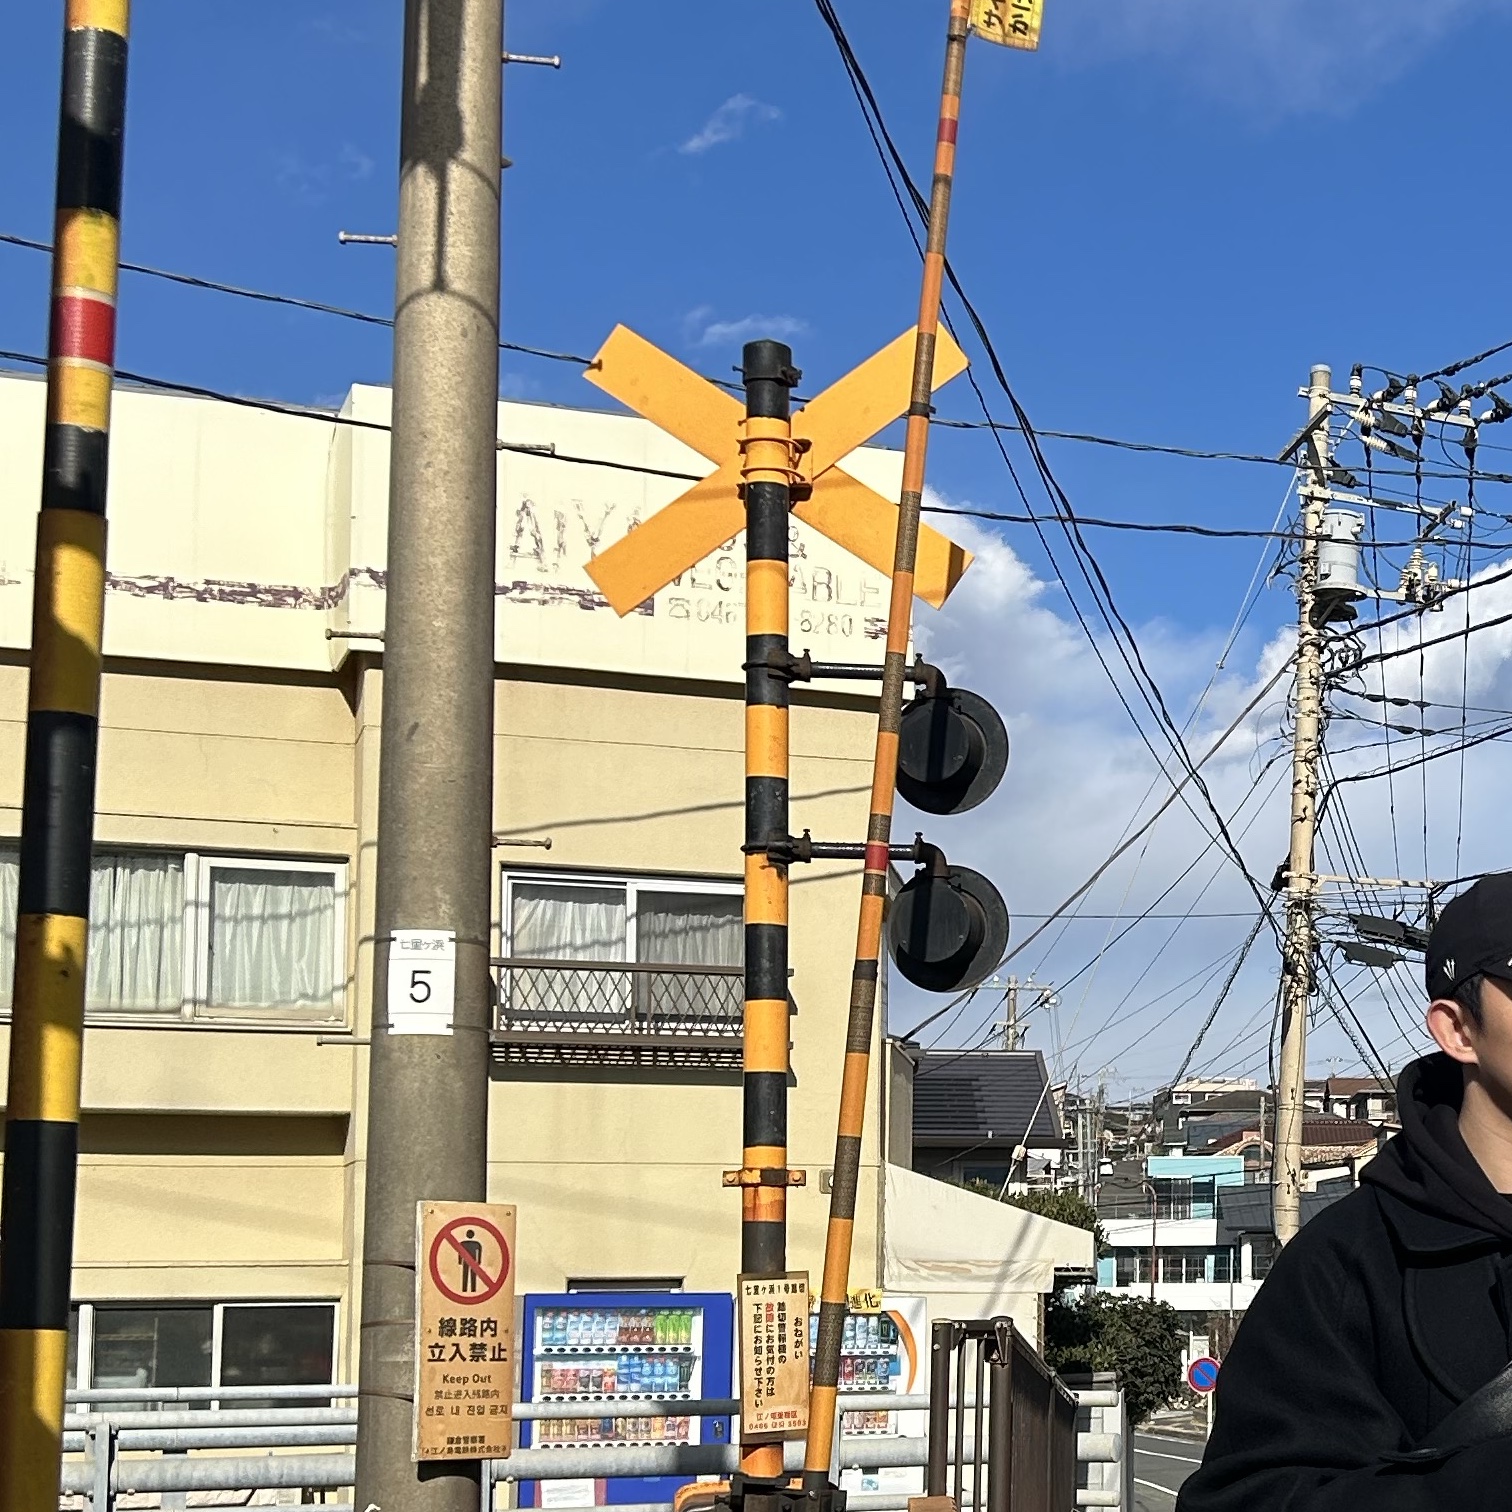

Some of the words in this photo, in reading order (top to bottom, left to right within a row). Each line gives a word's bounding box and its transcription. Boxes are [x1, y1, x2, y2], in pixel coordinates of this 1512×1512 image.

[409, 969, 432, 1004] 5
[438, 1317, 498, 1338] 線路内
[793, 1317, 803, 1360] おねがい
[427, 1342, 508, 1363] 立入禁止
[752, 1303, 763, 1408] 下記にお知らせ下さい
[442, 1373, 469, 1385] Keep
[472, 1373, 492, 1384] Out
